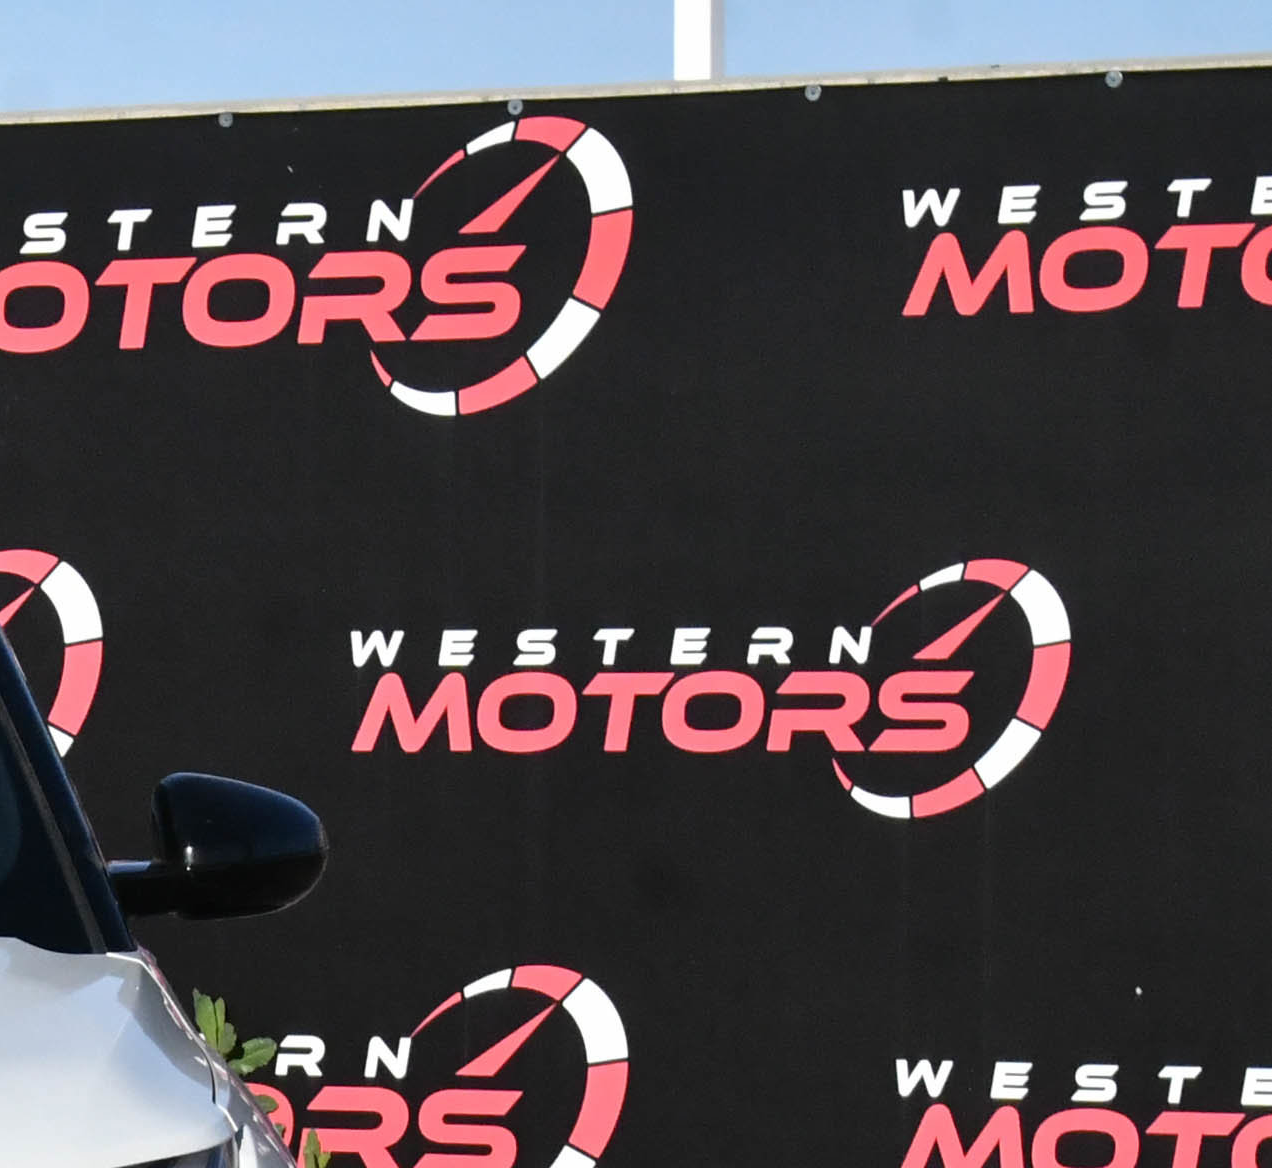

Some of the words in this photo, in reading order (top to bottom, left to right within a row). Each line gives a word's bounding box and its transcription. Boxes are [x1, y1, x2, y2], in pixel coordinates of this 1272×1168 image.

[350, 626, 872, 667] WESTERN
[350, 669, 975, 754] MOTORS
[895, 1059, 1272, 1106] WESTE
